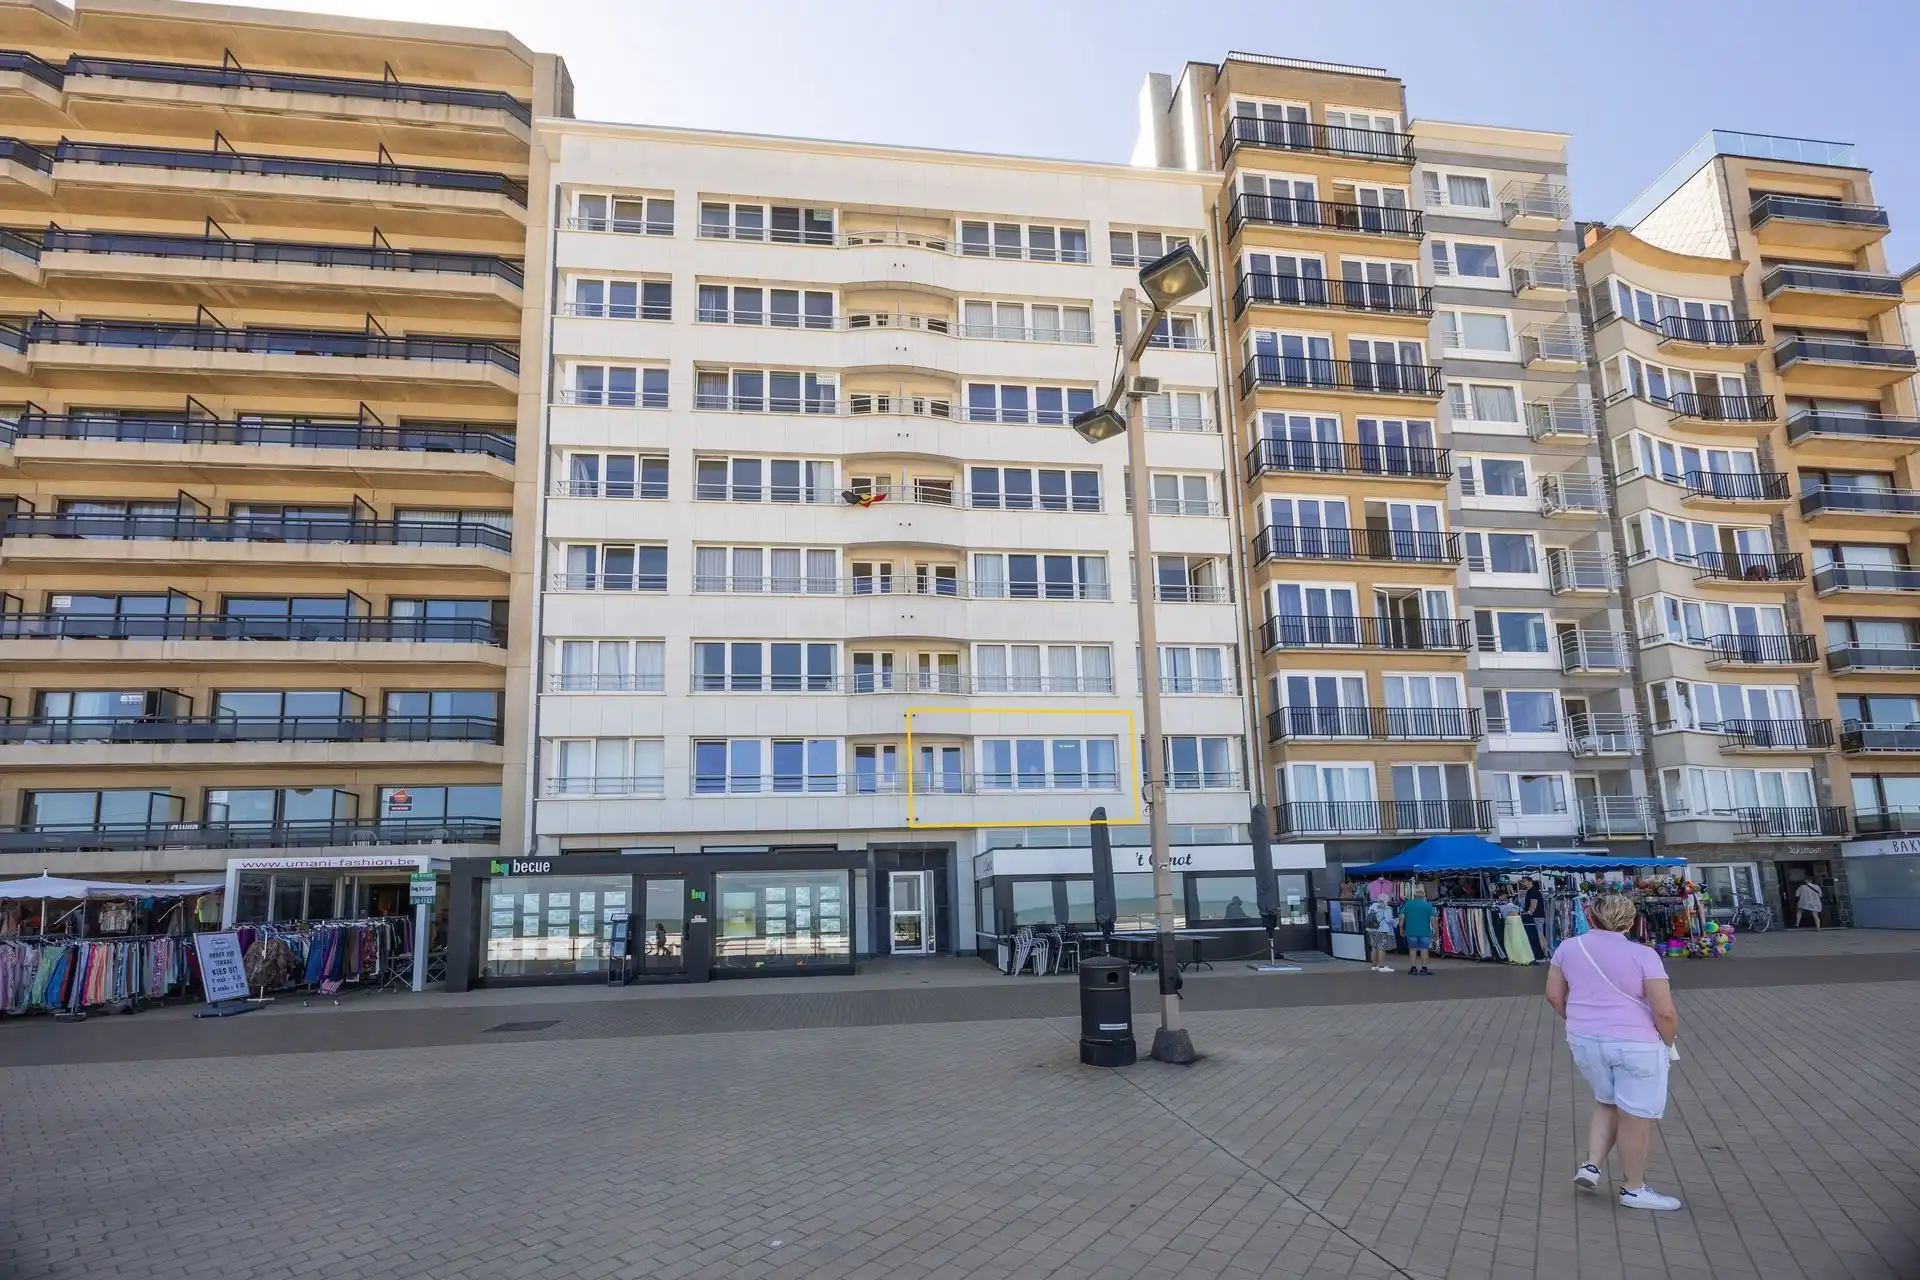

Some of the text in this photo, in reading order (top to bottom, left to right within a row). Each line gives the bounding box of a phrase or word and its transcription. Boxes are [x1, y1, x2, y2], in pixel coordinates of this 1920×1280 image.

[242, 858, 415, 868] www.umani-fashion.be
[1136, 852, 1144, 866] 't
[513, 859, 550, 873] becue
[211, 967, 227, 976] KIES
